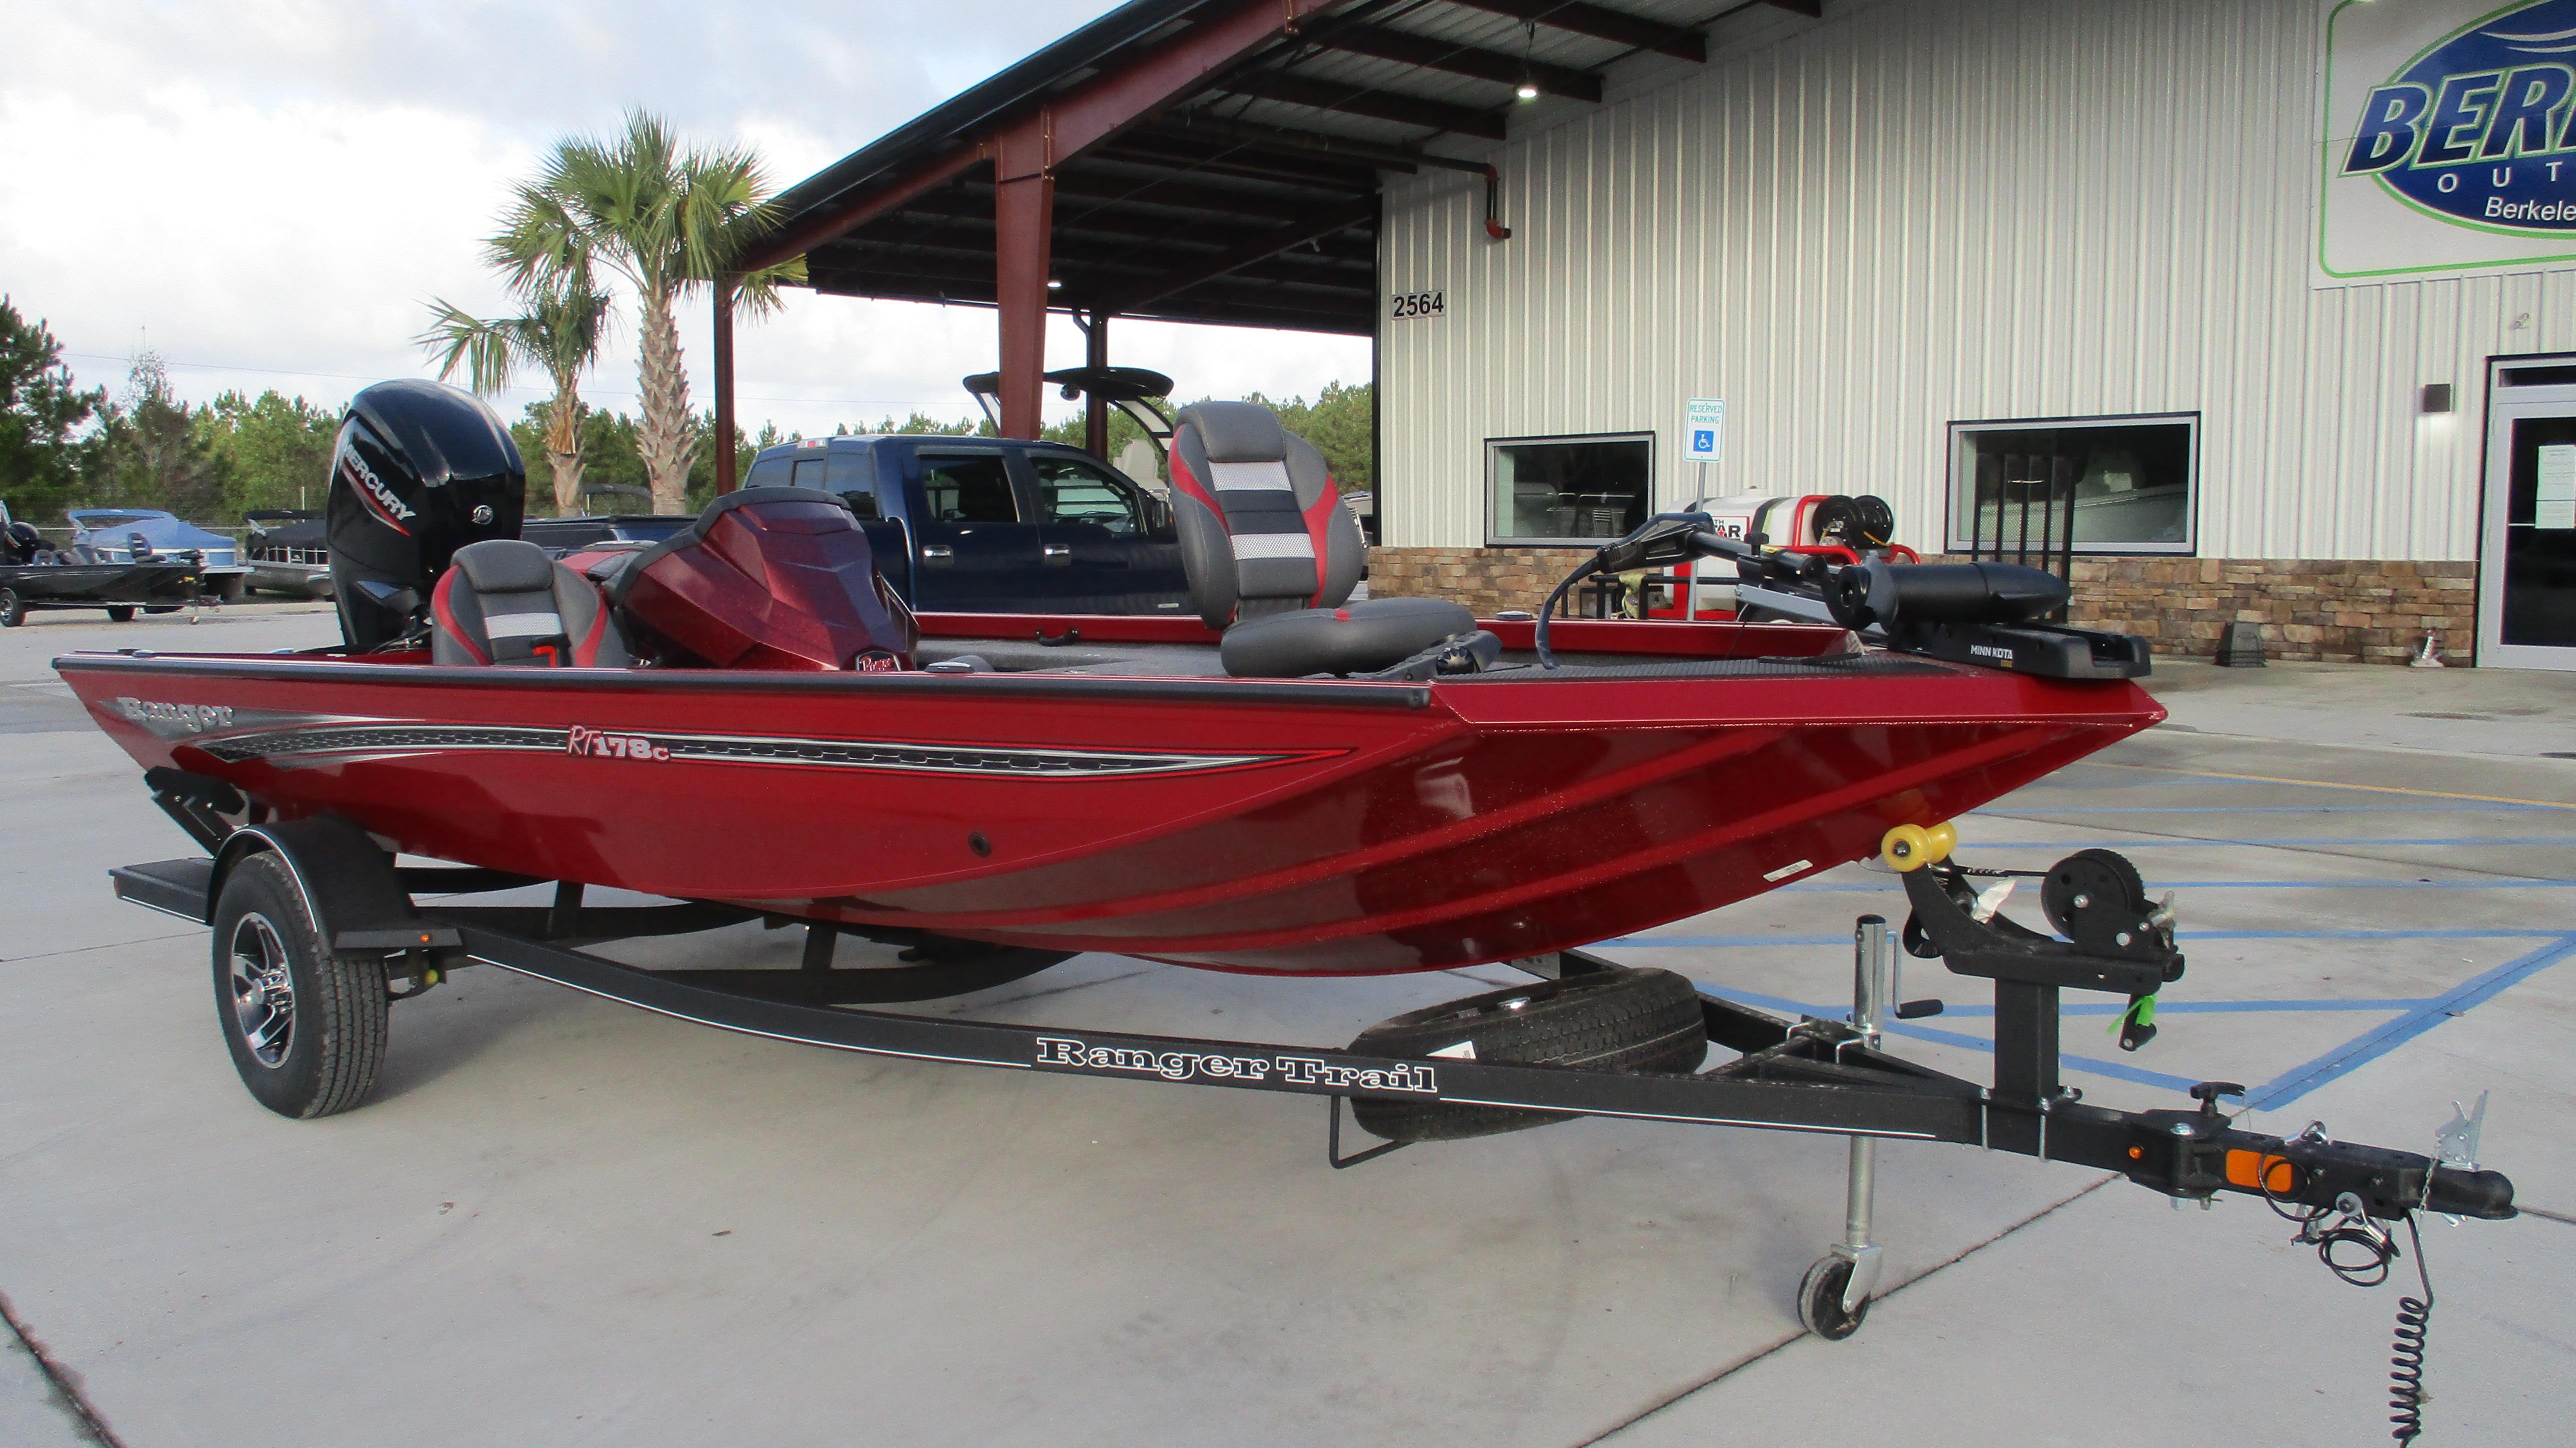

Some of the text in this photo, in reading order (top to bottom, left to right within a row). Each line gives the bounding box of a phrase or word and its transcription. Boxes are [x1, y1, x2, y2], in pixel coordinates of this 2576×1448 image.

[2484, 196, 2576, 222] Berkele
[1393, 292, 1444, 317] 2564
[1690, 404, 1722, 414] RESERVED
[1691, 415, 1720, 424] PARKING
[1970, 644, 2013, 660] MINN KOTA
[116, 696, 234, 733] Ranger
[1036, 1036, 1438, 1094] Ranger Trail
